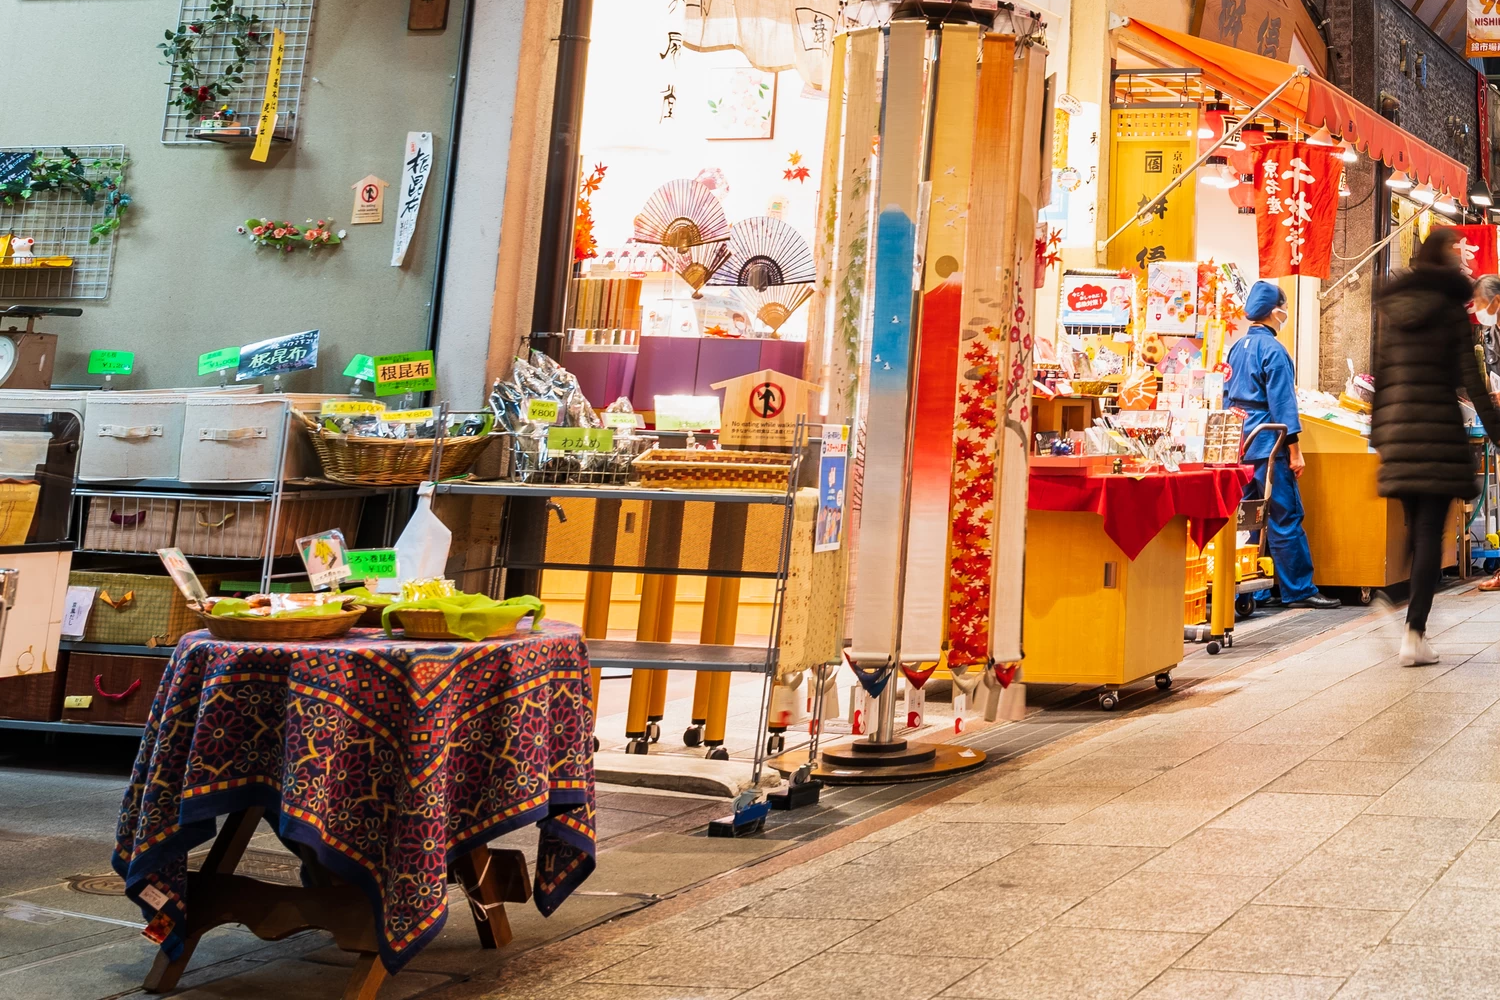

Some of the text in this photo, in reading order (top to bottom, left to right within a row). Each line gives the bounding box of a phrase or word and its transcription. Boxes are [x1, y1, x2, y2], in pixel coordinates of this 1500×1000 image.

[249, 346, 307, 370] 根昆布
[380, 362, 430, 380] 根昆布
[531, 409, 555, 418] ¥800
[562, 437, 600, 448] わかめ
[369, 565, 393, 573] ¥100
